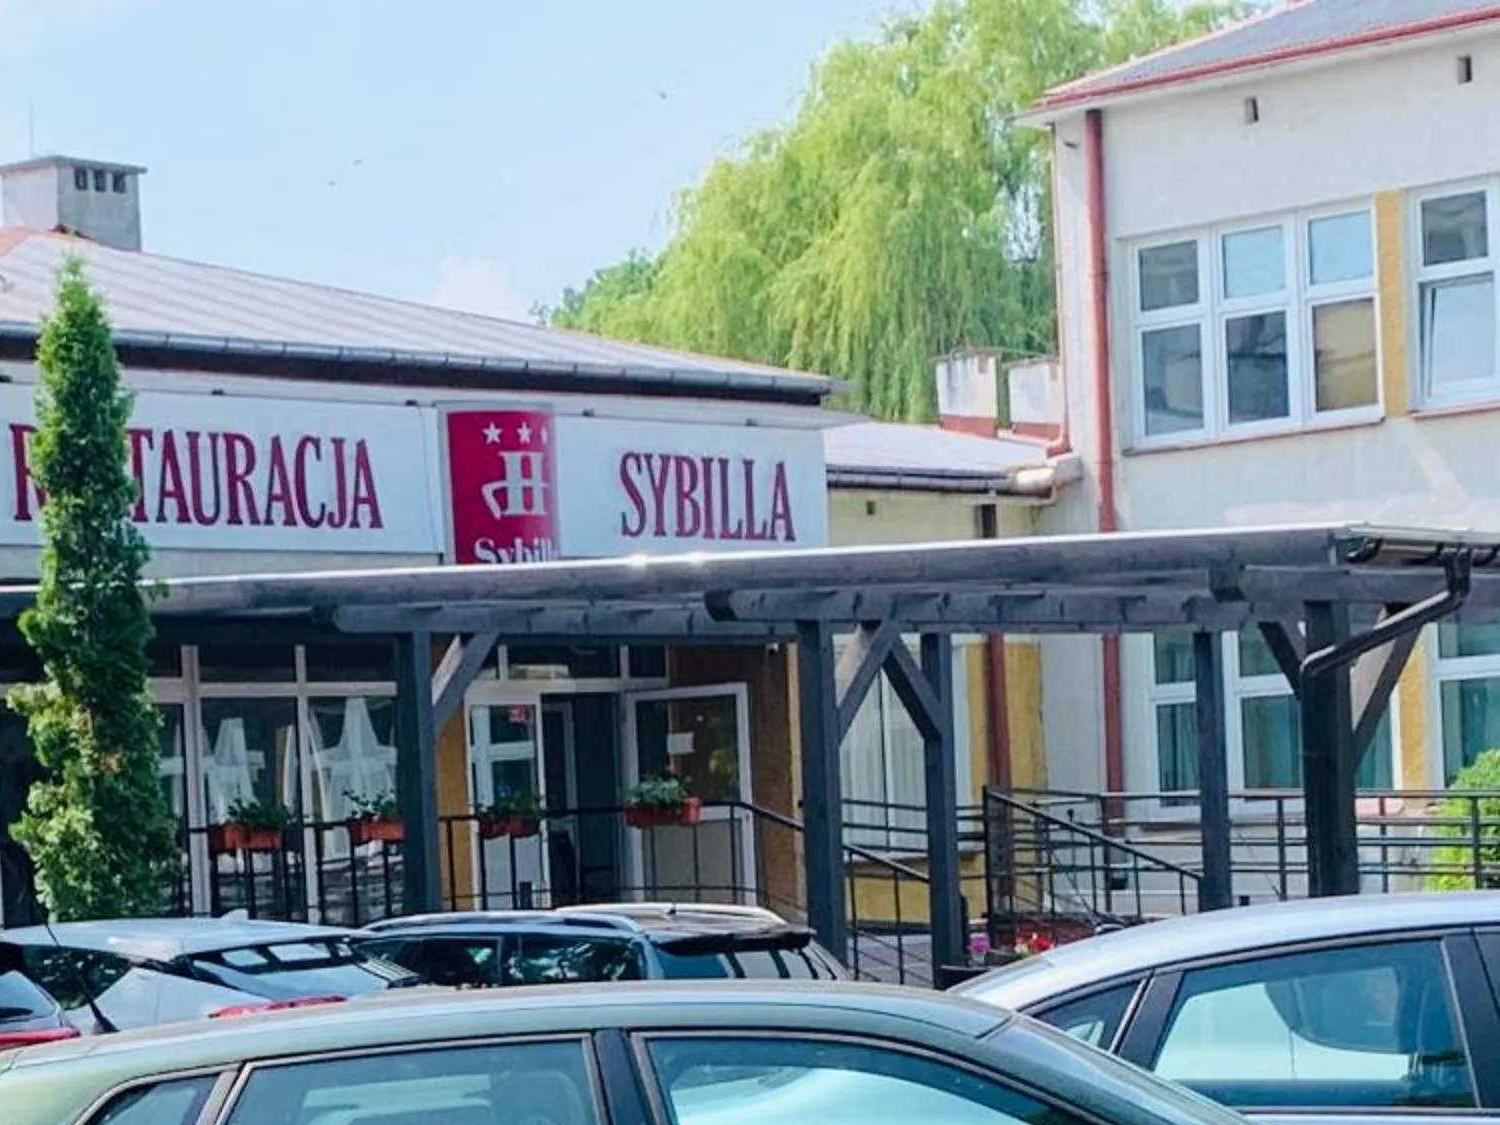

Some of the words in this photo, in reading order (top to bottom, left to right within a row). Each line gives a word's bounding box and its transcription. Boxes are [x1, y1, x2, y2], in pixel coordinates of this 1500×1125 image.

[9, 423, 384, 529] RTAURACJA
[619, 451, 796, 542] SYBILLA
[474, 536, 558, 564] Sbill
